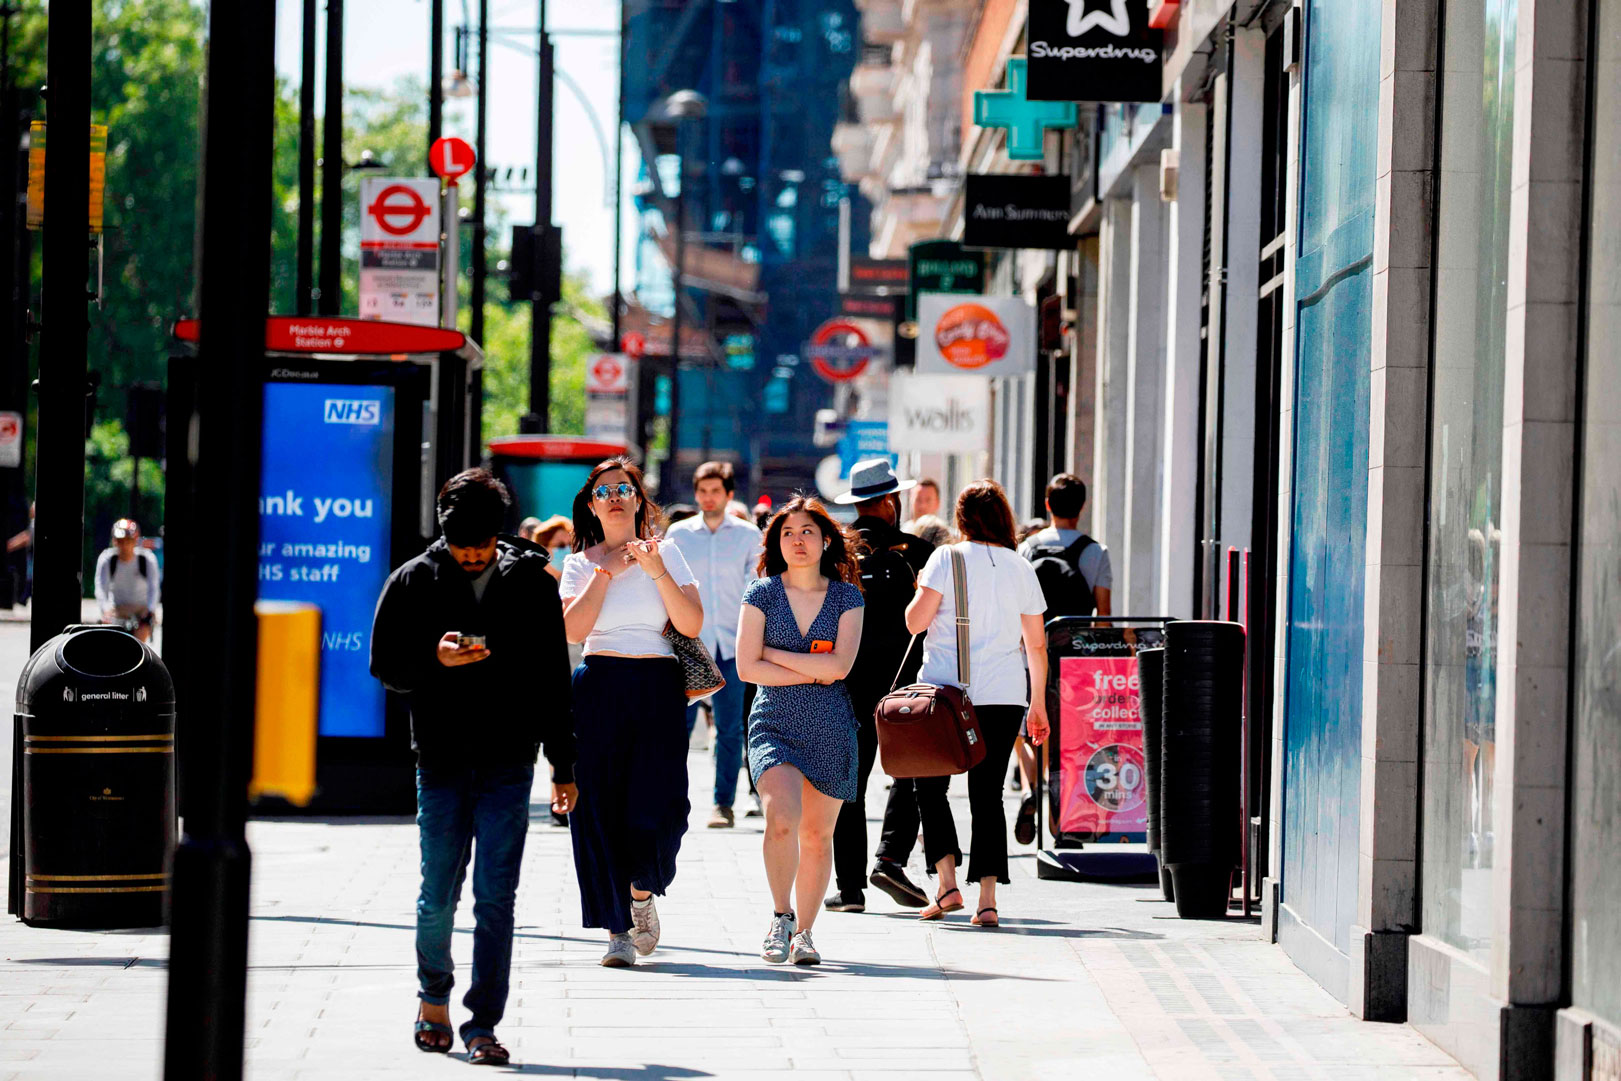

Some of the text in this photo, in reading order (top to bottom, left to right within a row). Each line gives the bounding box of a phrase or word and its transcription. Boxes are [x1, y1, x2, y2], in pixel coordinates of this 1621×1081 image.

[1030, 41, 1158, 63] Superdrug
[443, 141, 464, 173] L
[289, 325, 351, 337] Marble Arch
[295, 336, 331, 347] Station
[327, 403, 376, 421] NHS
[313, 498, 373, 524] you
[282, 541, 371, 563] amazing
[290, 564, 339, 582] staff
[322, 632, 363, 651] NHS
[1072, 640, 1148, 652] Superdrug
[1093, 670, 1140, 690] free
[81, 691, 129, 701] general litter
[1095, 763, 1139, 790] 30
[1105, 789, 1132, 799] mins
